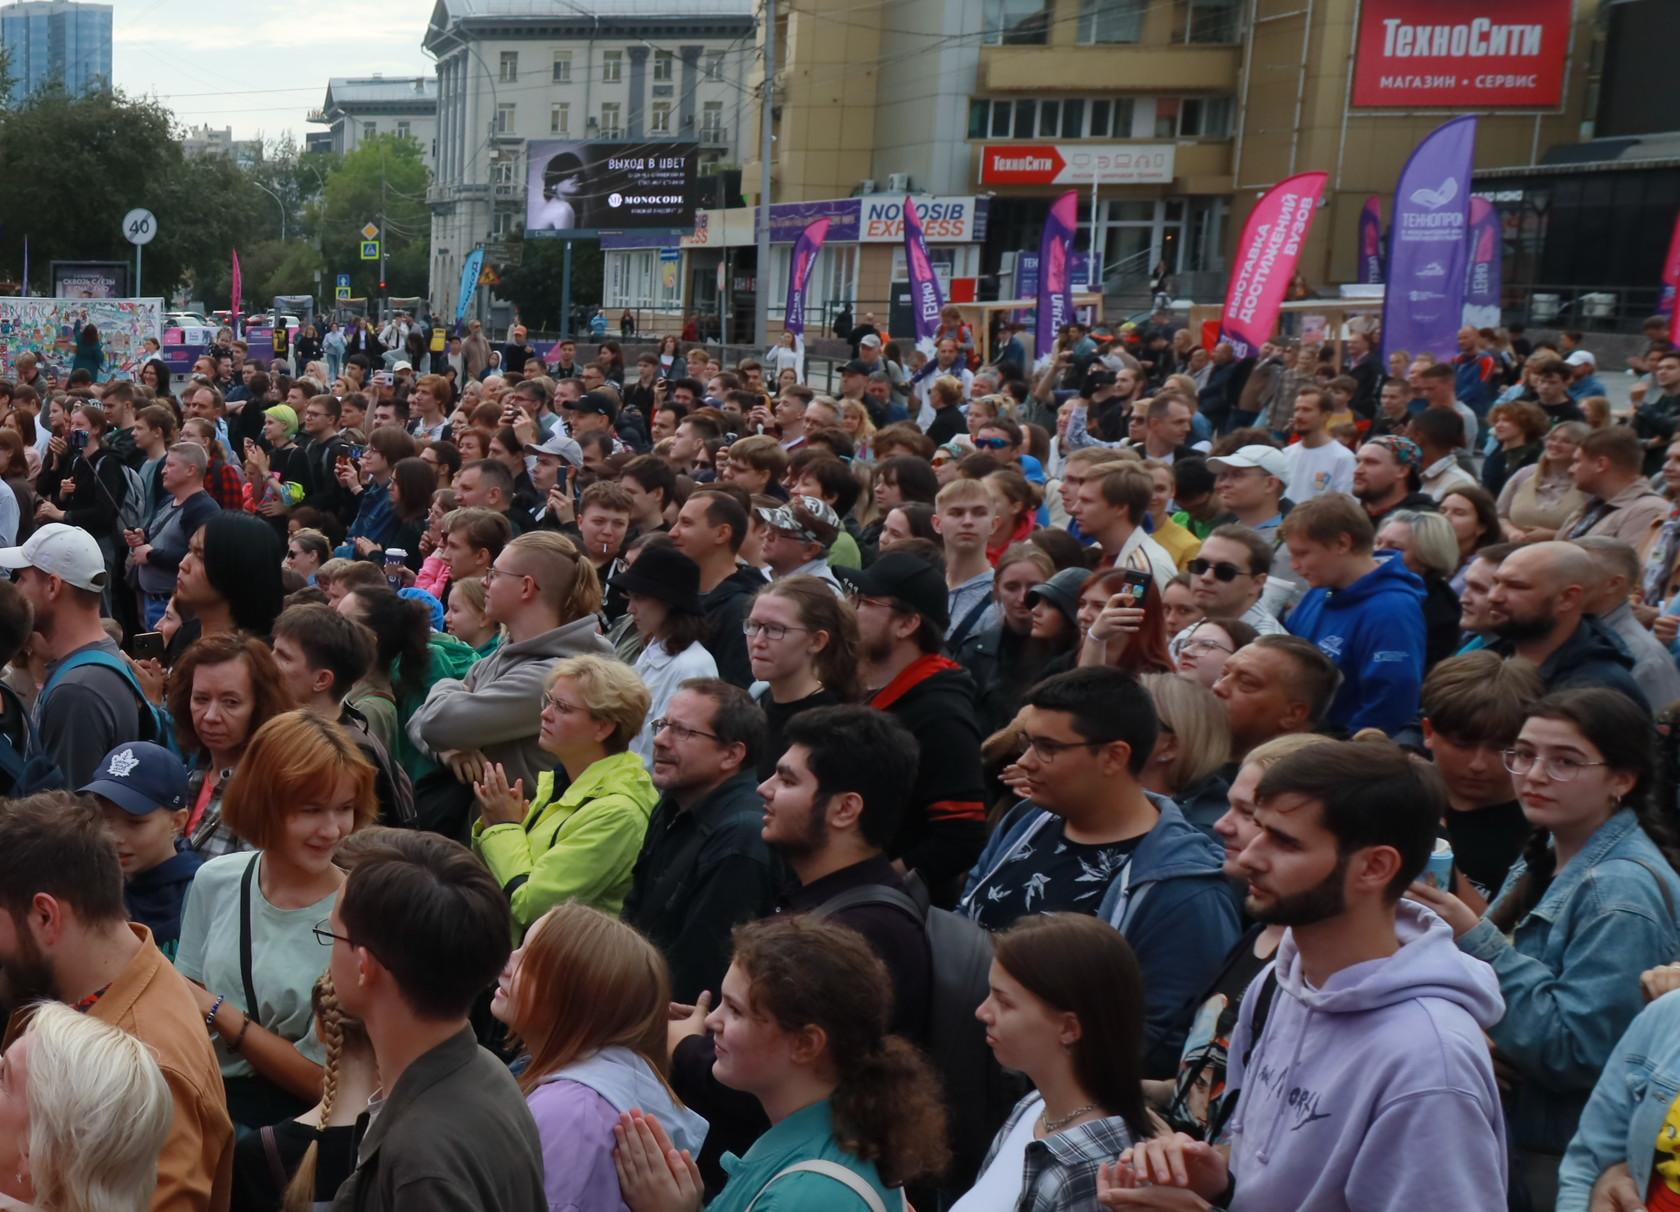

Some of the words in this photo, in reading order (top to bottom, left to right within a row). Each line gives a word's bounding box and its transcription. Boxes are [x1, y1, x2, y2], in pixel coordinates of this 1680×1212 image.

[1383, 17, 1542, 57] ТехноСити
[1380, 75, 1456, 89] МАГАЗИН
[1475, 74, 1537, 88] СЕРВИС
[608, 158, 644, 169] ВЫХОД
[648, 158, 655, 169] В
[659, 157, 685, 169] ЦВЕТ
[993, 156, 1053, 171] ТехноСити
[868, 203, 965, 220] NOOSIB
[129, 220, 150, 234] 40
[867, 220, 964, 237] EXPESS
[1283, 197, 1313, 256] ВУЗОВ
[1239, 193, 1298, 324] ДОСТИЖЕНИЙ
[1228, 224, 1270, 318] ВЫСТАВКА
